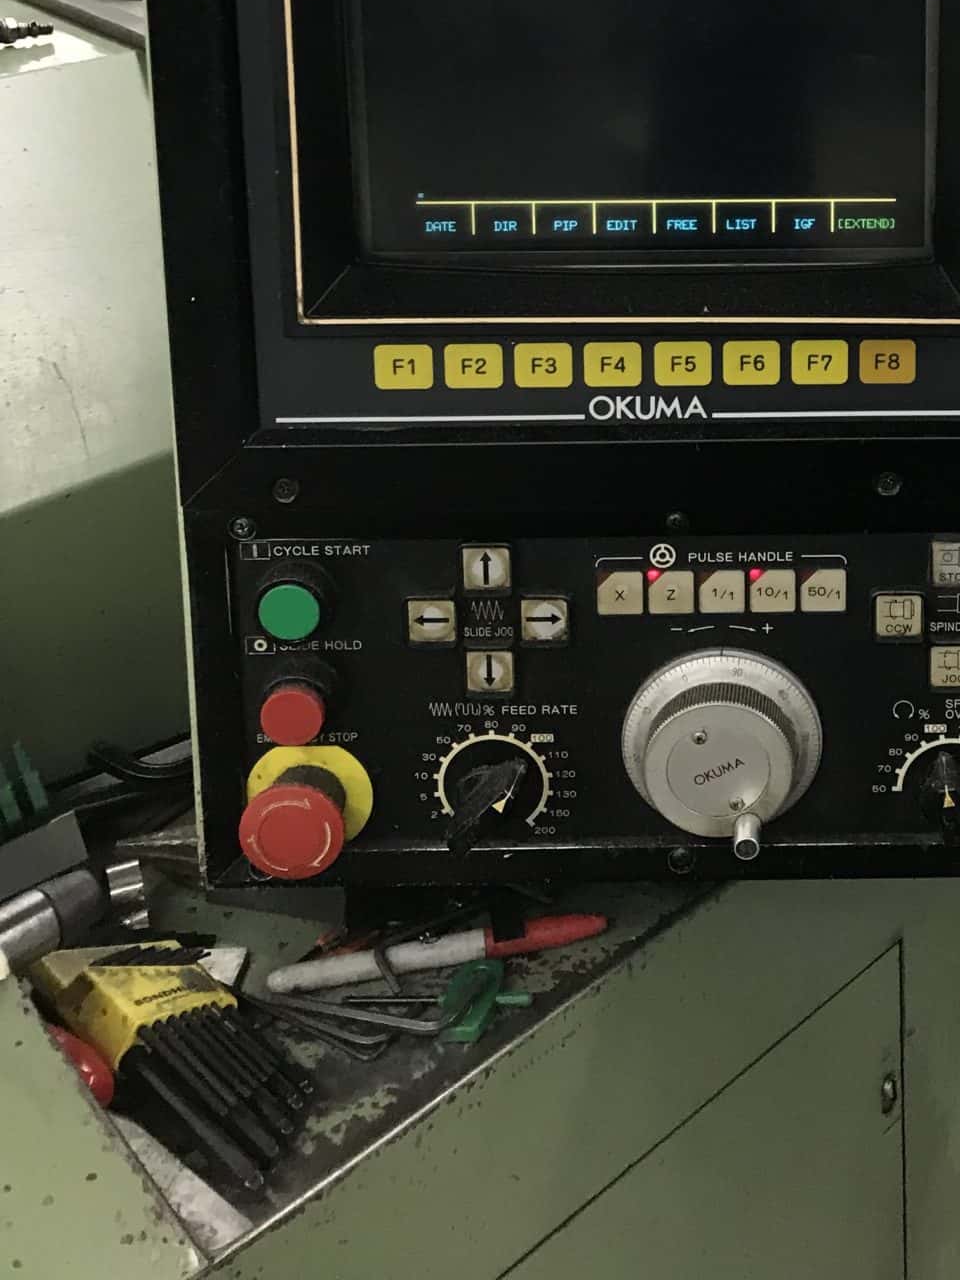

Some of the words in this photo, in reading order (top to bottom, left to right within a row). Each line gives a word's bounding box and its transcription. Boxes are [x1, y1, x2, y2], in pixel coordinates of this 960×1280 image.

[425, 221, 457, 232] DATE
[494, 220, 518, 232] DIR
[553, 220, 578, 231] PIP
[606, 219, 638, 231] EDIT
[666, 219, 697, 231] FREE
[726, 219, 757, 230] LIST
[794, 218, 816, 230] IGF
[392, 358, 415, 375] F1
[461, 358, 487, 375] F2
[531, 357, 557, 374] F3
[600, 356, 626, 373] F4
[671, 356, 696, 372] F5
[740, 355, 765, 371] F6
[807, 354, 833, 371] F7
[874, 353, 900, 370] F8
[588, 394, 708, 420] OKUMA
[273, 544, 321, 557] CYCLE
[325, 544, 371, 556] START
[688, 552, 733, 563] PULSE
[738, 551, 793, 562] HANDLE
[615, 589, 625, 600] X
[666, 589, 676, 600] Z
[712, 588, 735, 600] 1/1
[756, 587, 790, 600] 10/1
[808, 586, 841, 600] 50/1
[464, 626, 492, 637] SLIDE
[494, 626, 513, 637] JOG
[885, 624, 913, 633] CCW
[325, 640, 362, 650] HOLD
[501, 705, 536, 715] FEED
[541, 705, 578, 715] RATE
[328, 732, 358, 742] STOP
[694, 758, 745, 786] OKUMA
